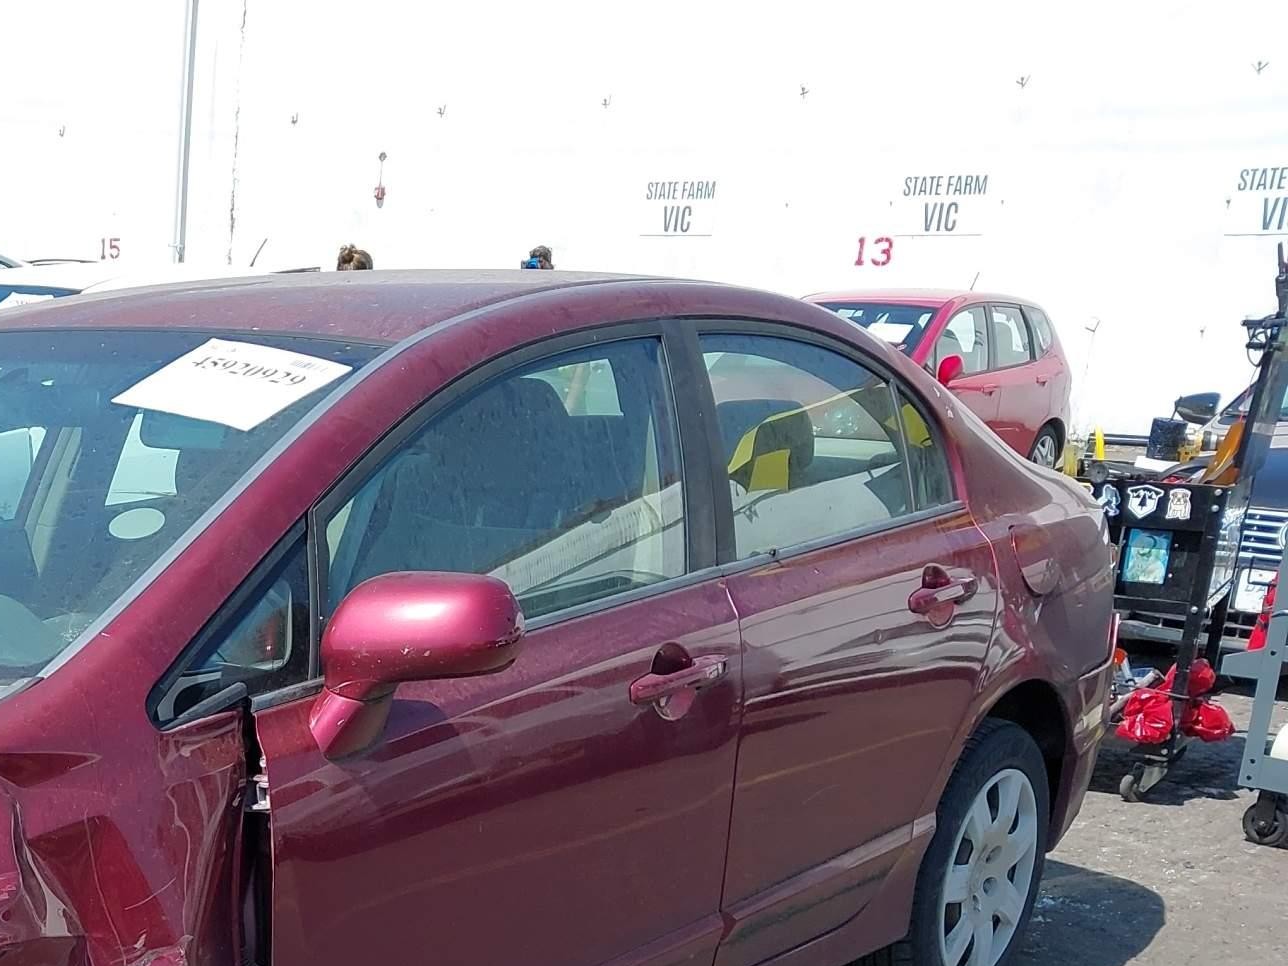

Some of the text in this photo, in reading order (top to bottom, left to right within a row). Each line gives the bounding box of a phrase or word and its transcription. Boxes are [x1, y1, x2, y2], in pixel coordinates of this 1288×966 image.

[646, 180, 717, 201] STATE FARM
[903, 174, 989, 197] STATE FARM
[1237, 166, 1288, 192] STATE
[663, 205, 692, 233] VIC
[924, 201, 959, 232] VIC
[1261, 196, 1288, 231] VI
[100, 237, 121, 260] 15
[853, 236, 894, 267] 13
